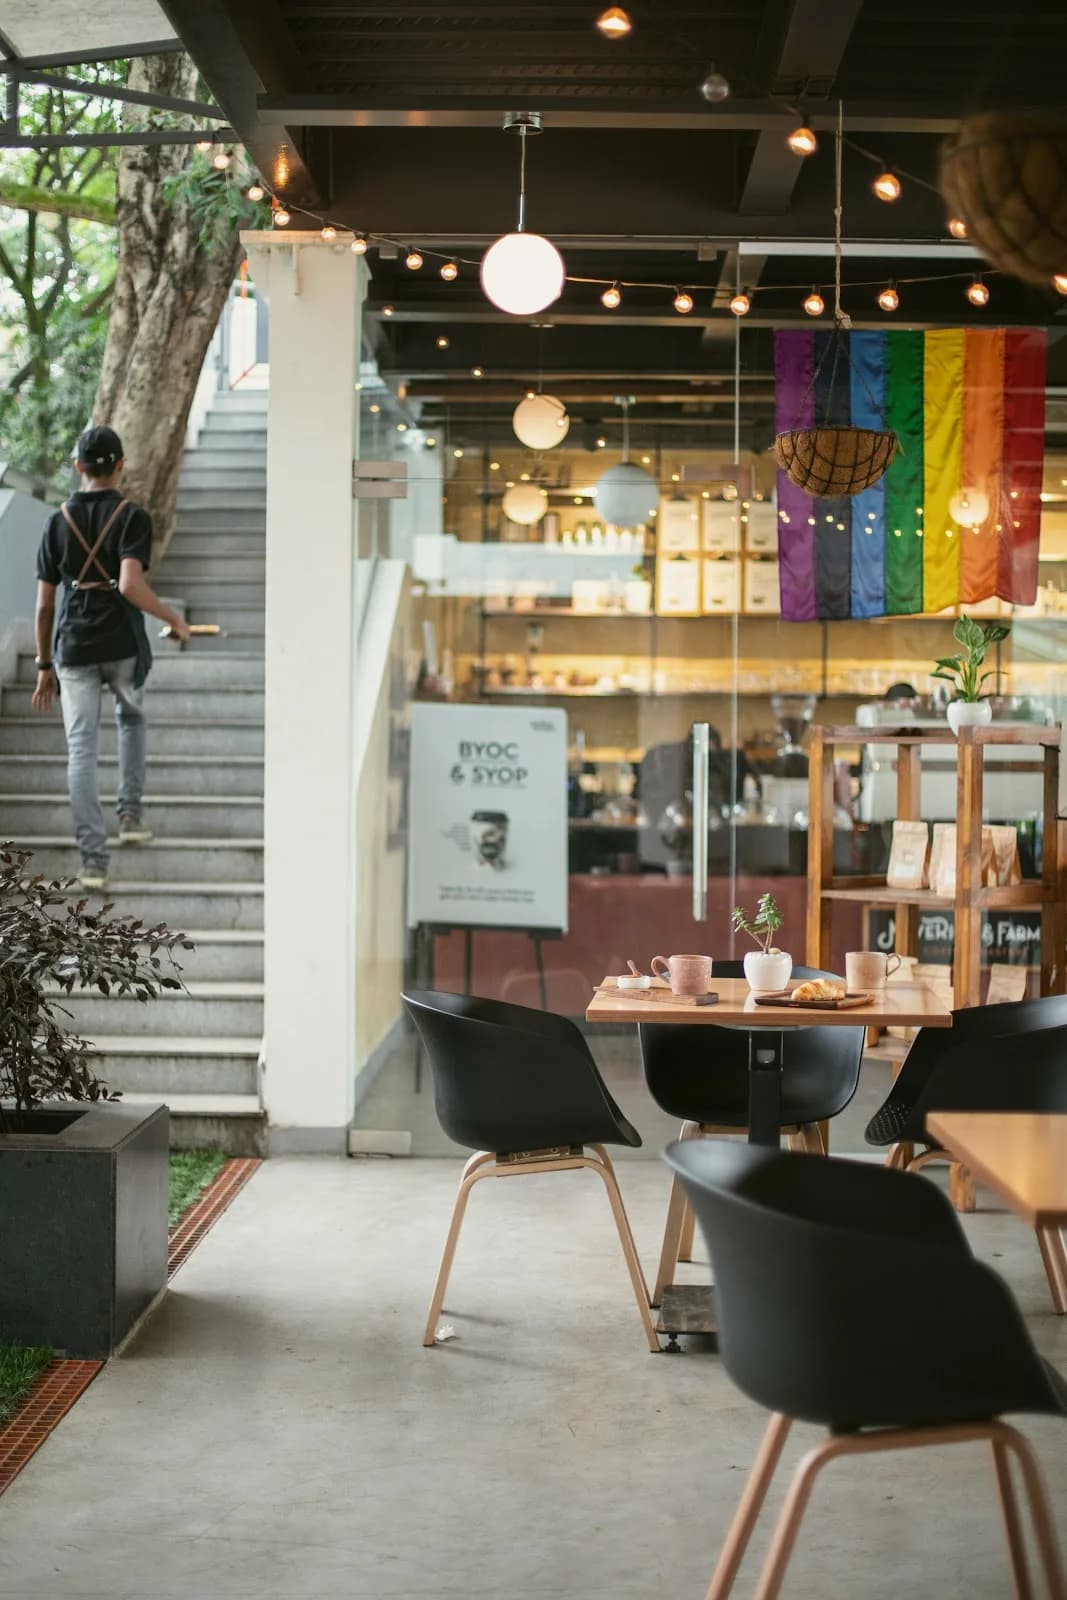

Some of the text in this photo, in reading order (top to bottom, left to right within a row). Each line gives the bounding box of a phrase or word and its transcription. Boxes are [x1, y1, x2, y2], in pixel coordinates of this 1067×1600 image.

[459, 741, 519, 760] BYOC
[449, 764, 528, 784] & SYOP
[997, 921, 1041, 947] FARM
